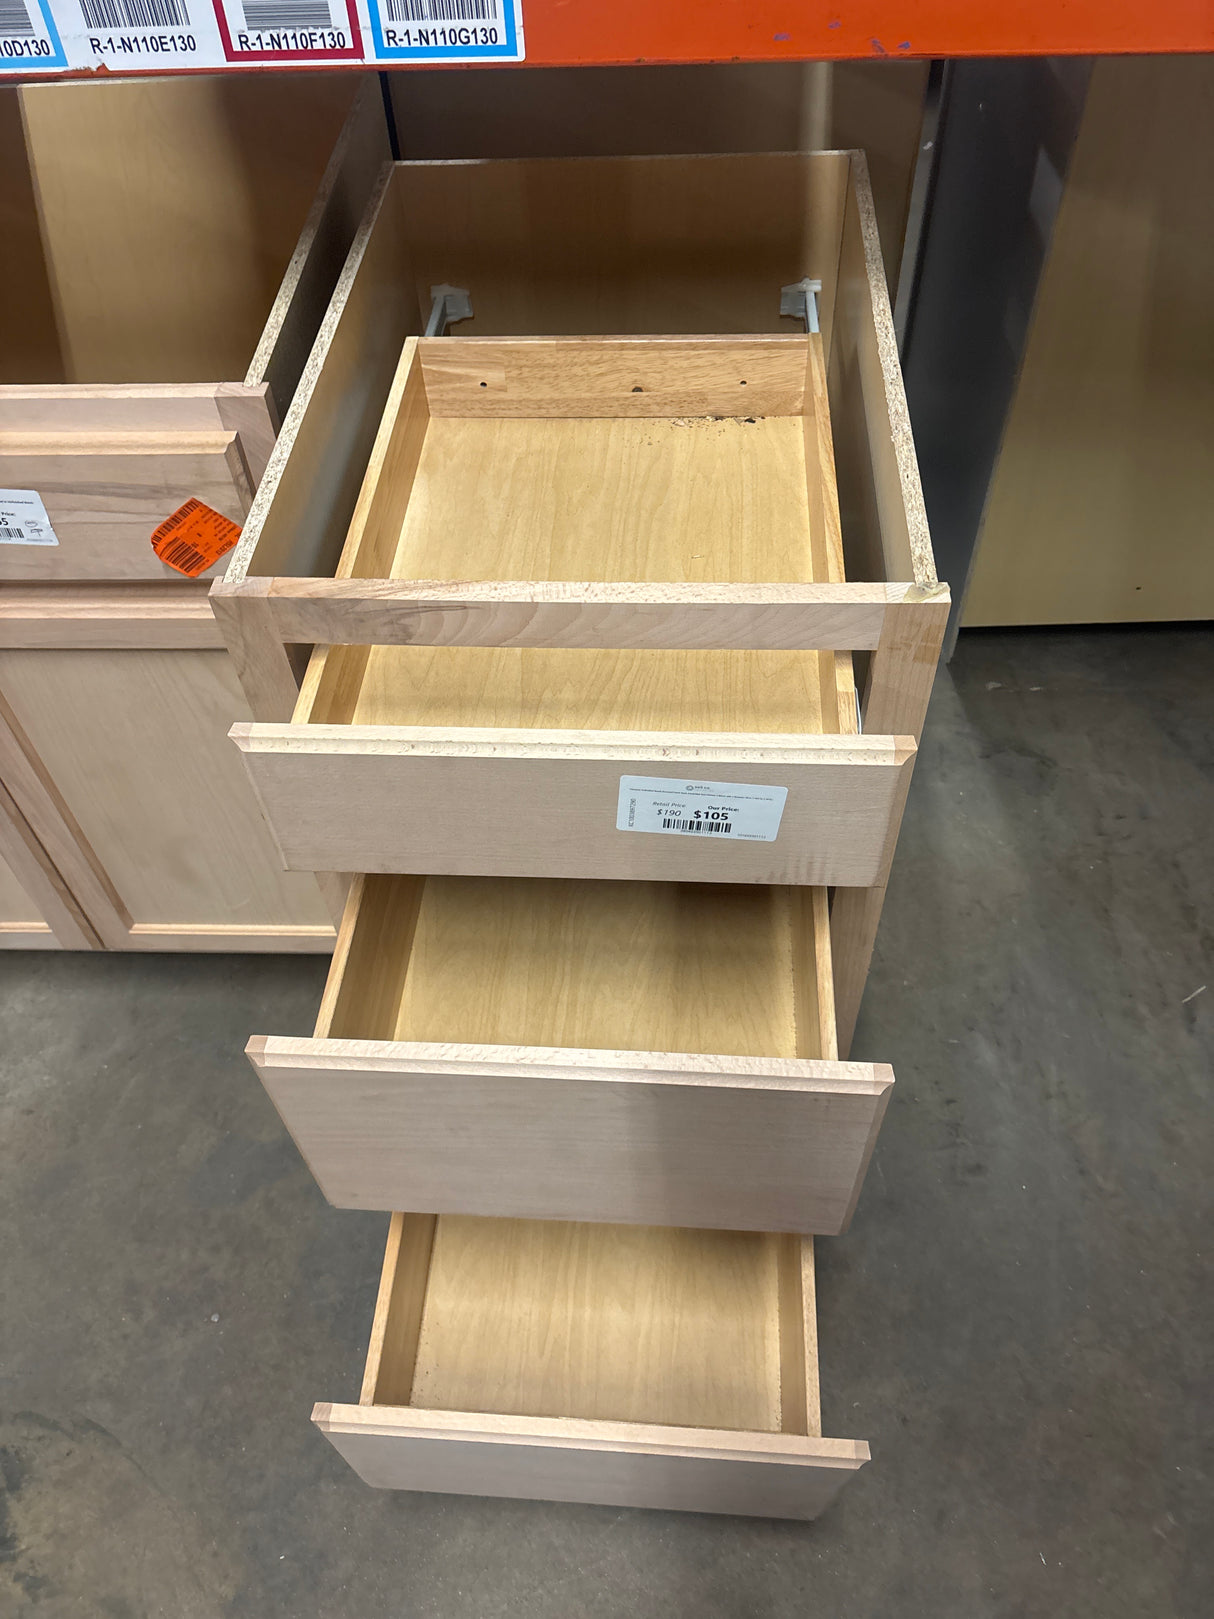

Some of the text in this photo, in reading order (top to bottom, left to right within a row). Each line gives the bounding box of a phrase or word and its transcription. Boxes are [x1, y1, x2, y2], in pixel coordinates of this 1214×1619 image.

[90, 34, 197, 54] R-1-N110E130
[238, 31, 346, 51] R-1-N110F130
[386, 27, 499, 48] R-1-N110G130
[656, 808, 682, 817] $190
[693, 809, 729, 821] $105
